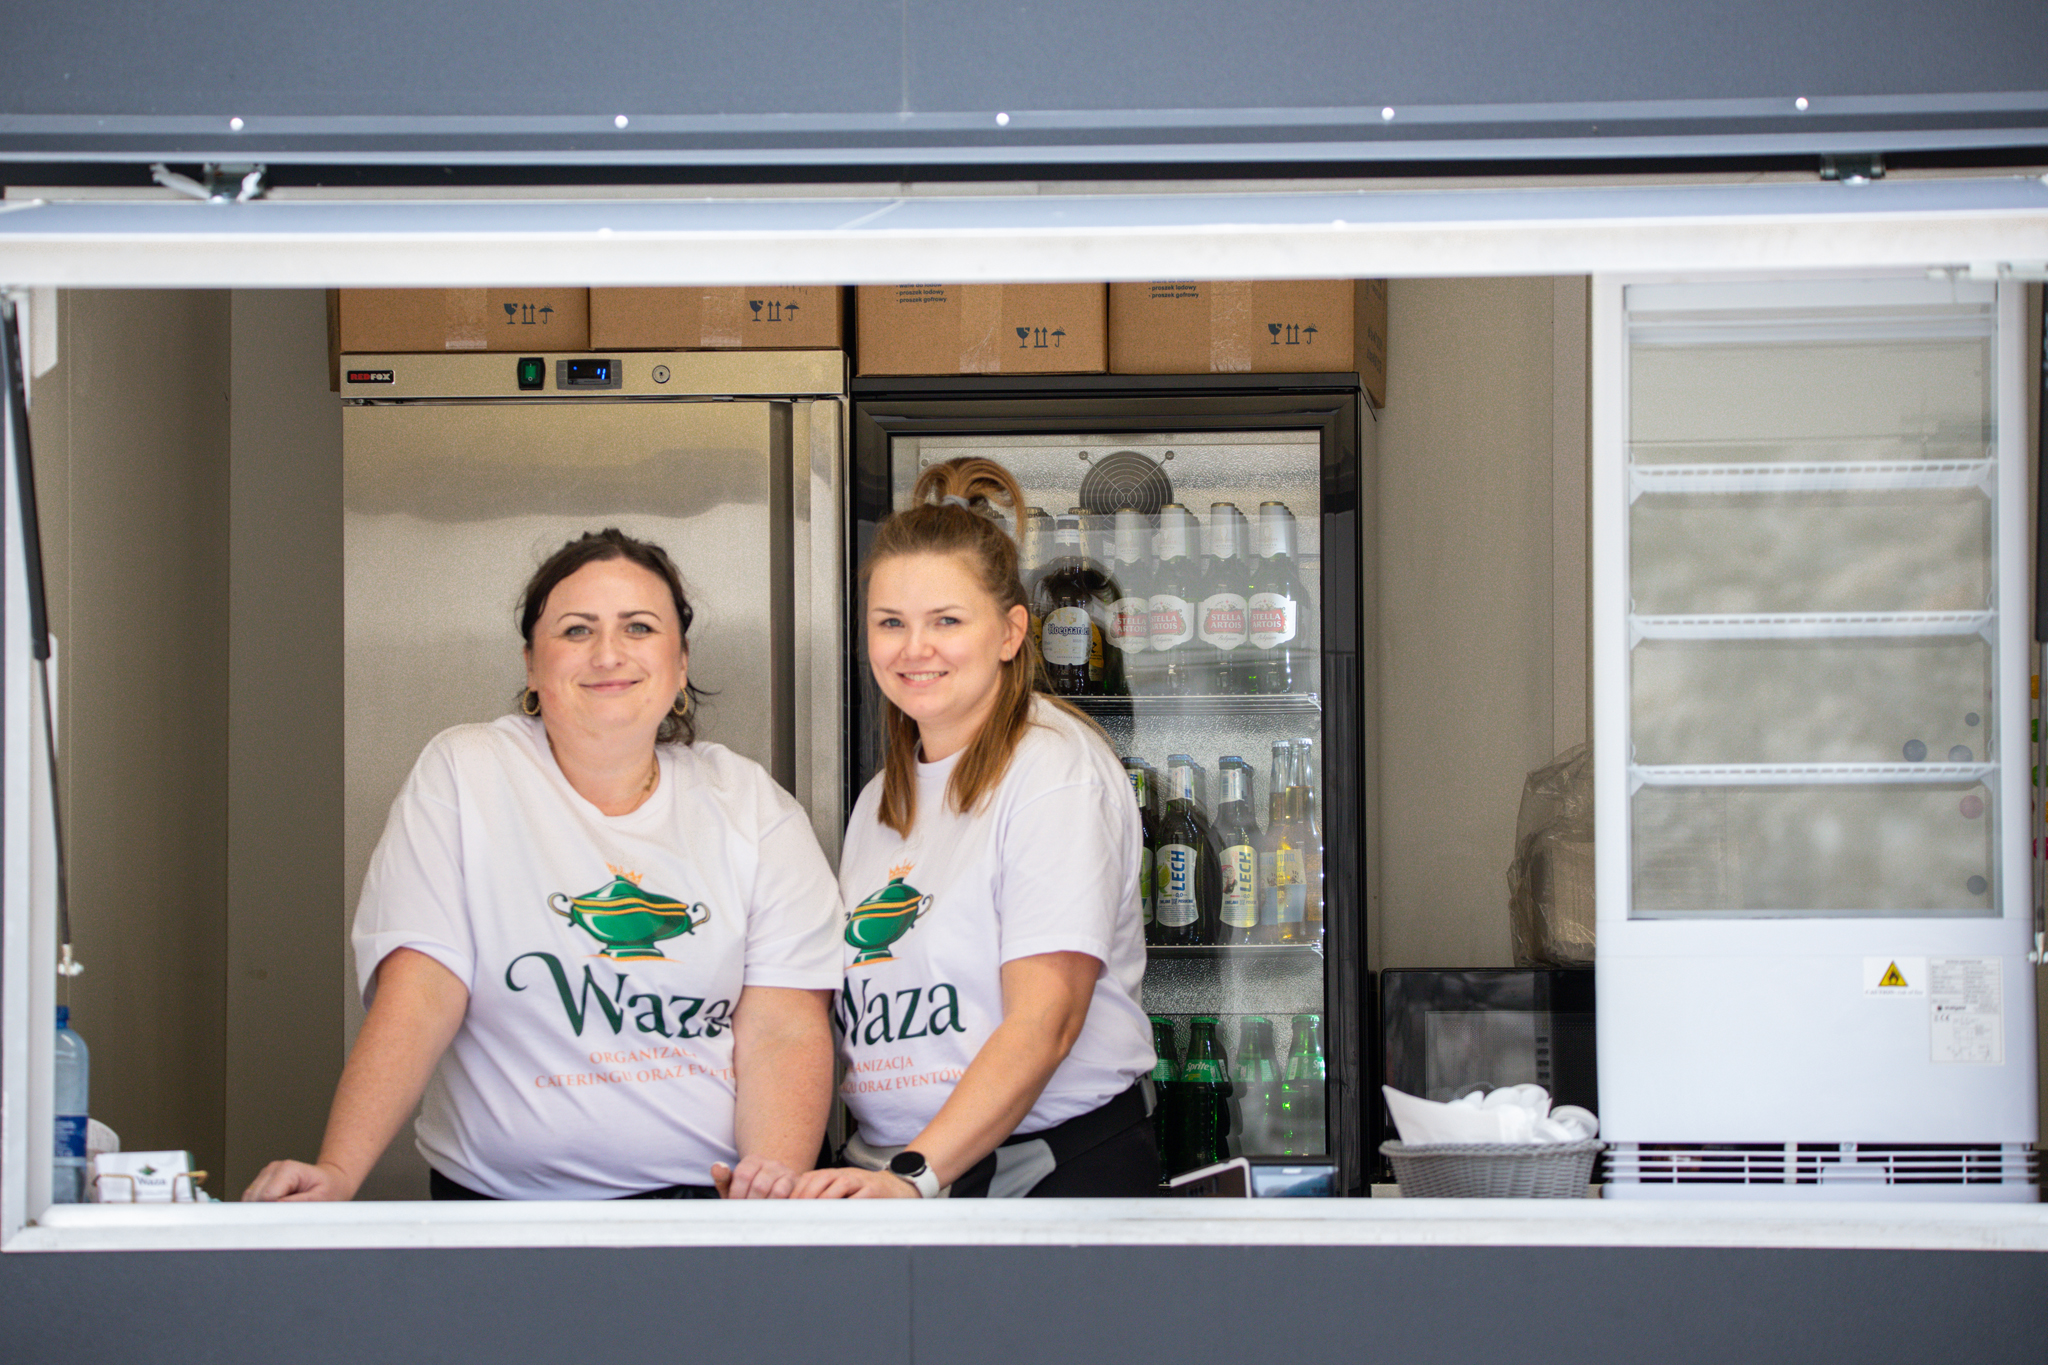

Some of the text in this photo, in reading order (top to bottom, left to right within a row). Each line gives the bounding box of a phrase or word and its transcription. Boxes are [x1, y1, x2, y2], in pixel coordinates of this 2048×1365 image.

[350, 373, 390, 381] REDFOX
[1117, 617, 1147, 625] STELLA
[1211, 613, 1241, 621] STELLA
[1253, 620, 1281, 628] ARTOIS
[1171, 850, 1185, 891] LECH
[1239, 852, 1251, 892] LECH
[505, 951, 731, 1038] Waza
[851, 1056, 914, 1074] ANIZACJA
[1186, 1061, 1210, 1072] Sprite
[636, 1065, 684, 1083] ORAZ
[858, 1078, 893, 1094] ORAZ
